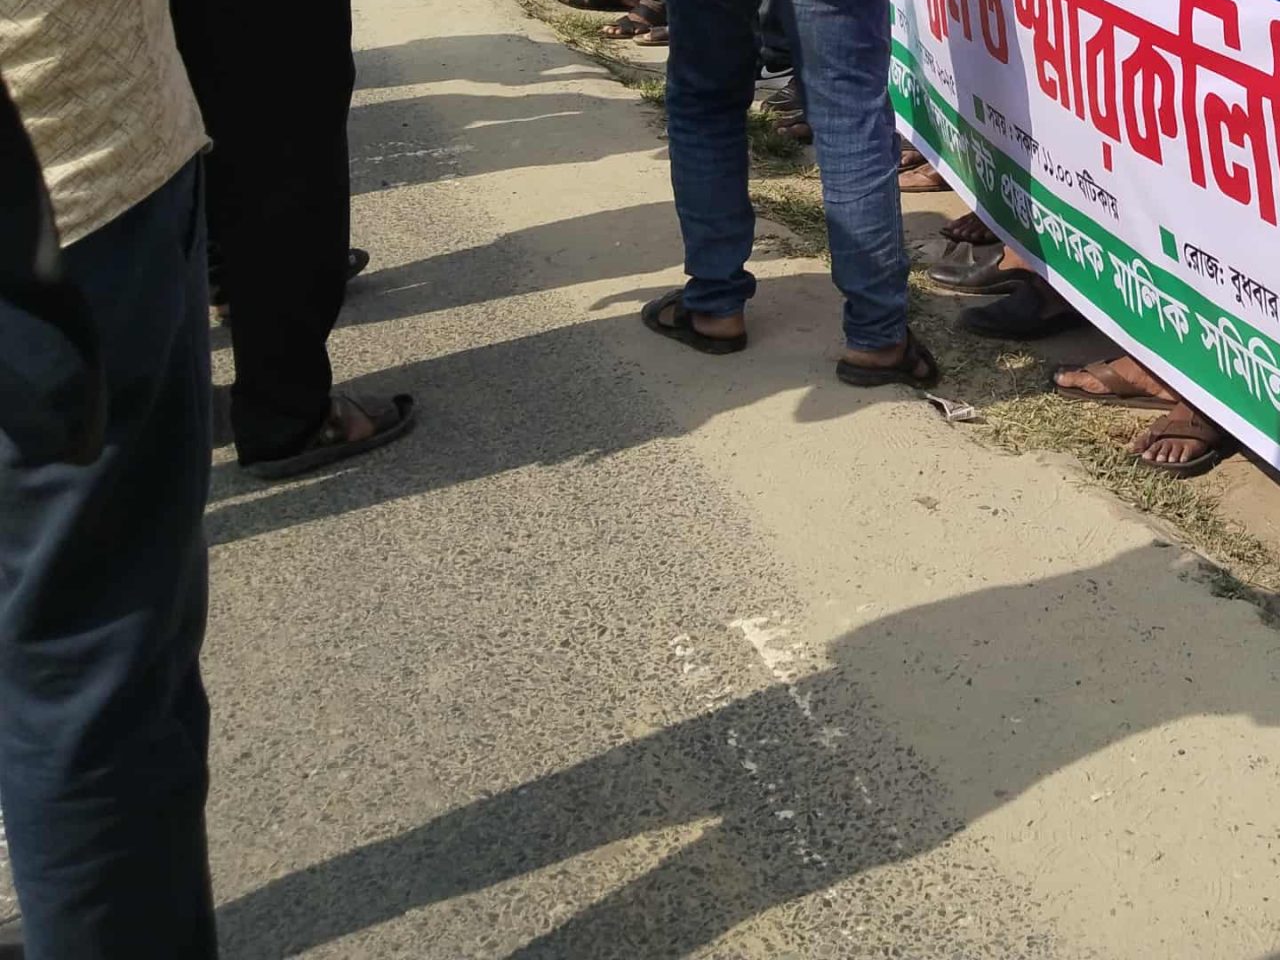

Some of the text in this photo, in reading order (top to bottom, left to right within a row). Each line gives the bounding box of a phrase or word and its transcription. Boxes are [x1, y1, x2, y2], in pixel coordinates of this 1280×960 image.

[1075, 168, 1121, 220] ঘটিকায়
[1107, 250, 1190, 344] মালিক
[1228, 266, 1280, 323] বুধবার
